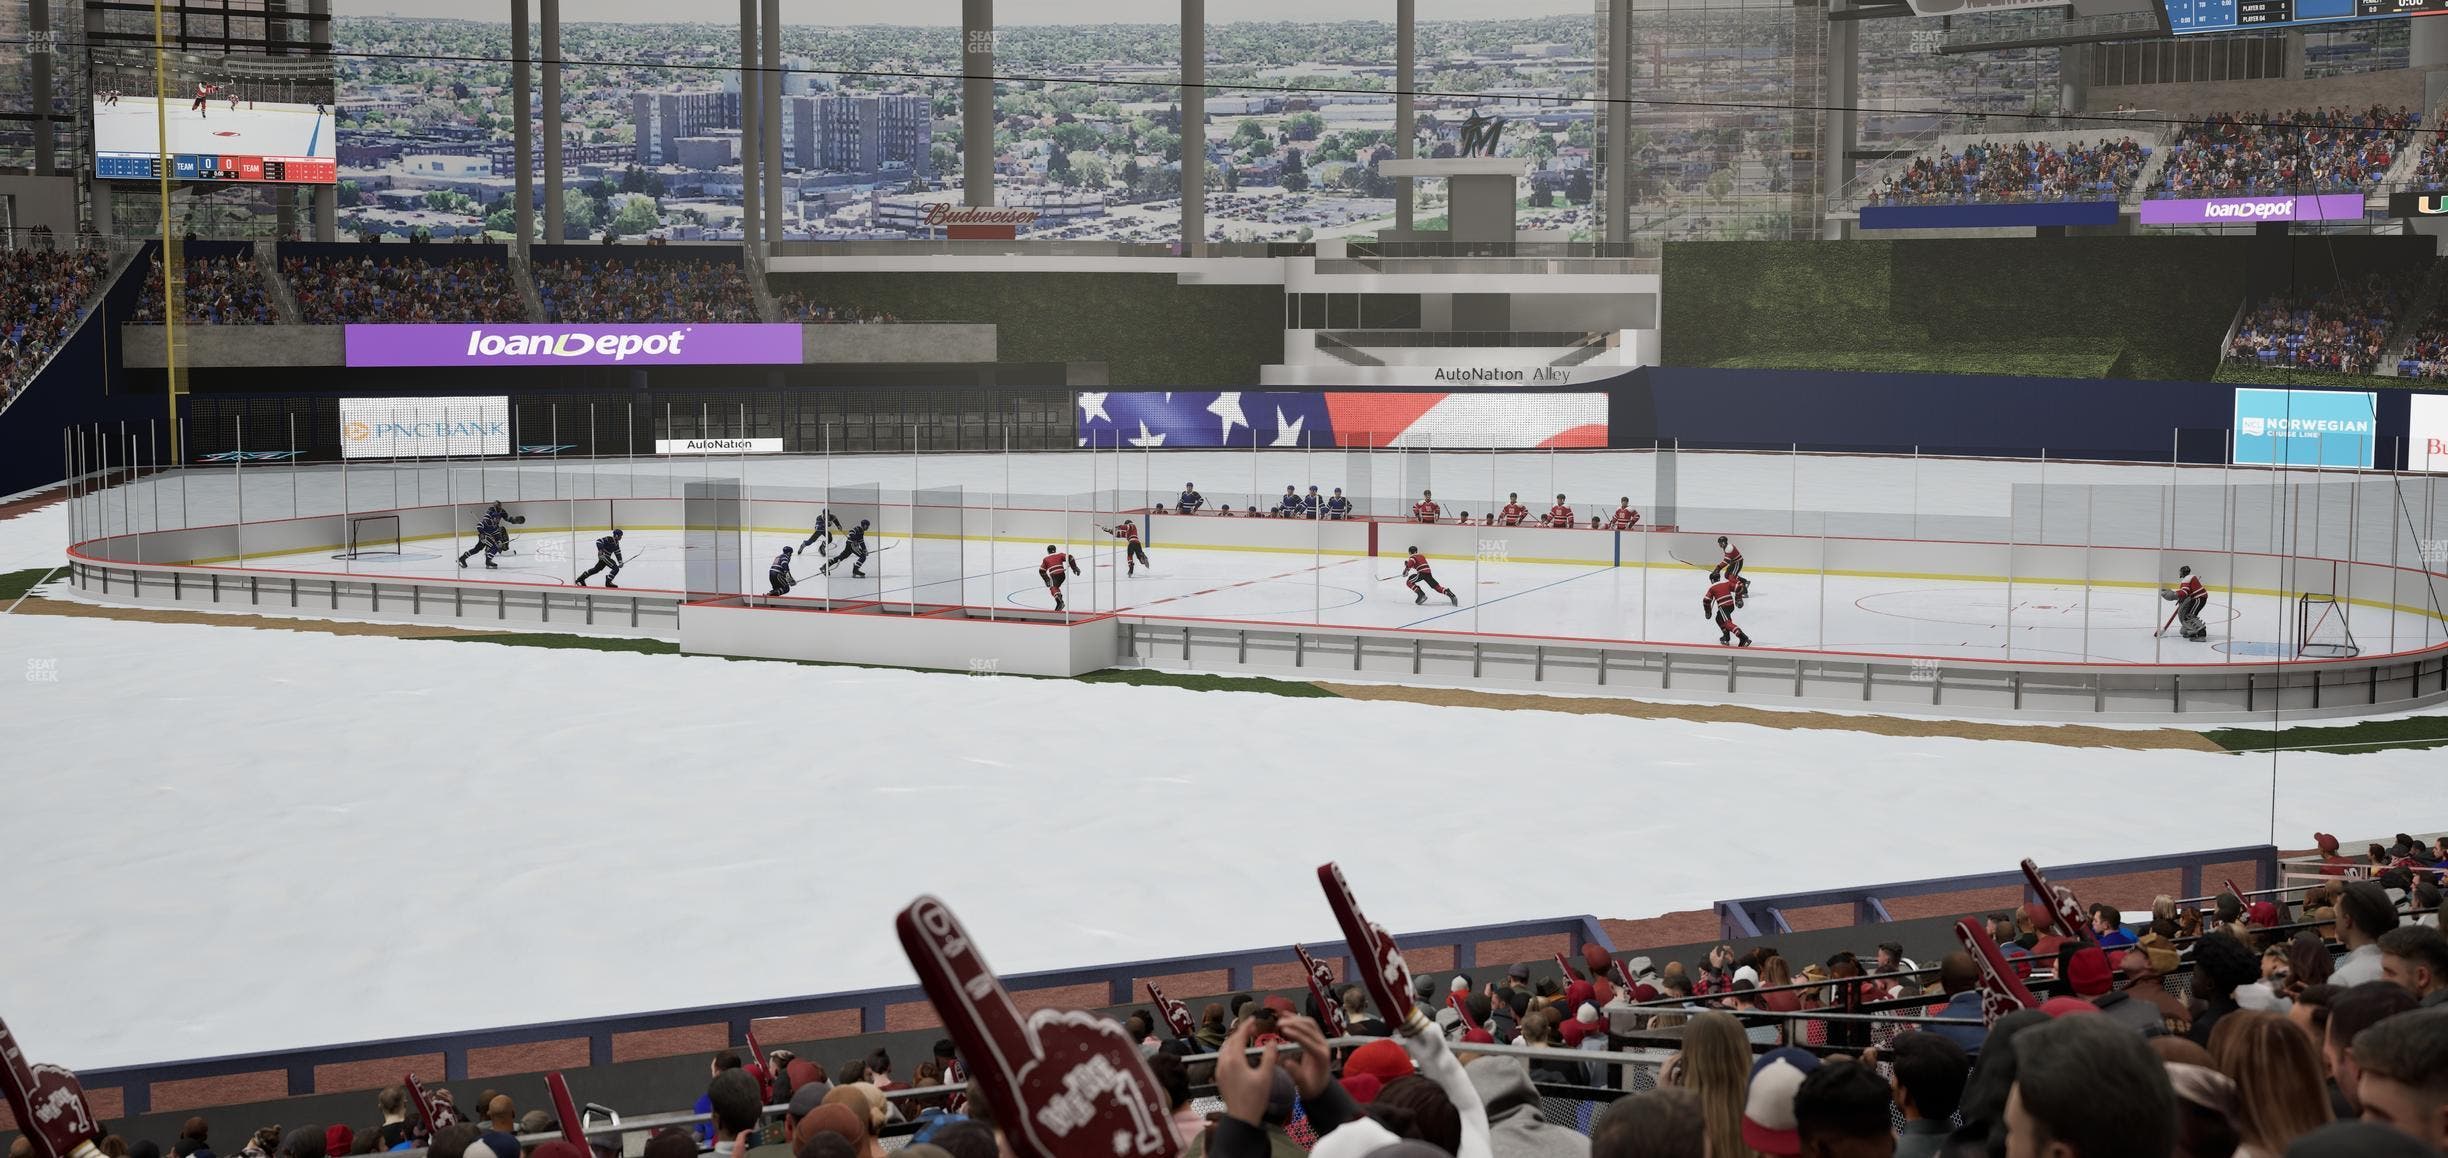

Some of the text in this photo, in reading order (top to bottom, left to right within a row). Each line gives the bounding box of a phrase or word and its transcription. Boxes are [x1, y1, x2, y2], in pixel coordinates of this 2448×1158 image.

[177, 162, 194, 171] TEAM
[205, 158, 212, 169] 0
[226, 159, 232, 169] 0
[242, 164, 260, 173] TEAM
[921, 202, 1040, 226] Budweiser
[2205, 200, 2293, 219] loanDepot
[467, 330, 685, 360] loanDepot
[1434, 366, 1571, 384] AutoNation Alley
[2267, 418, 2368, 432] NORWEGIAN
